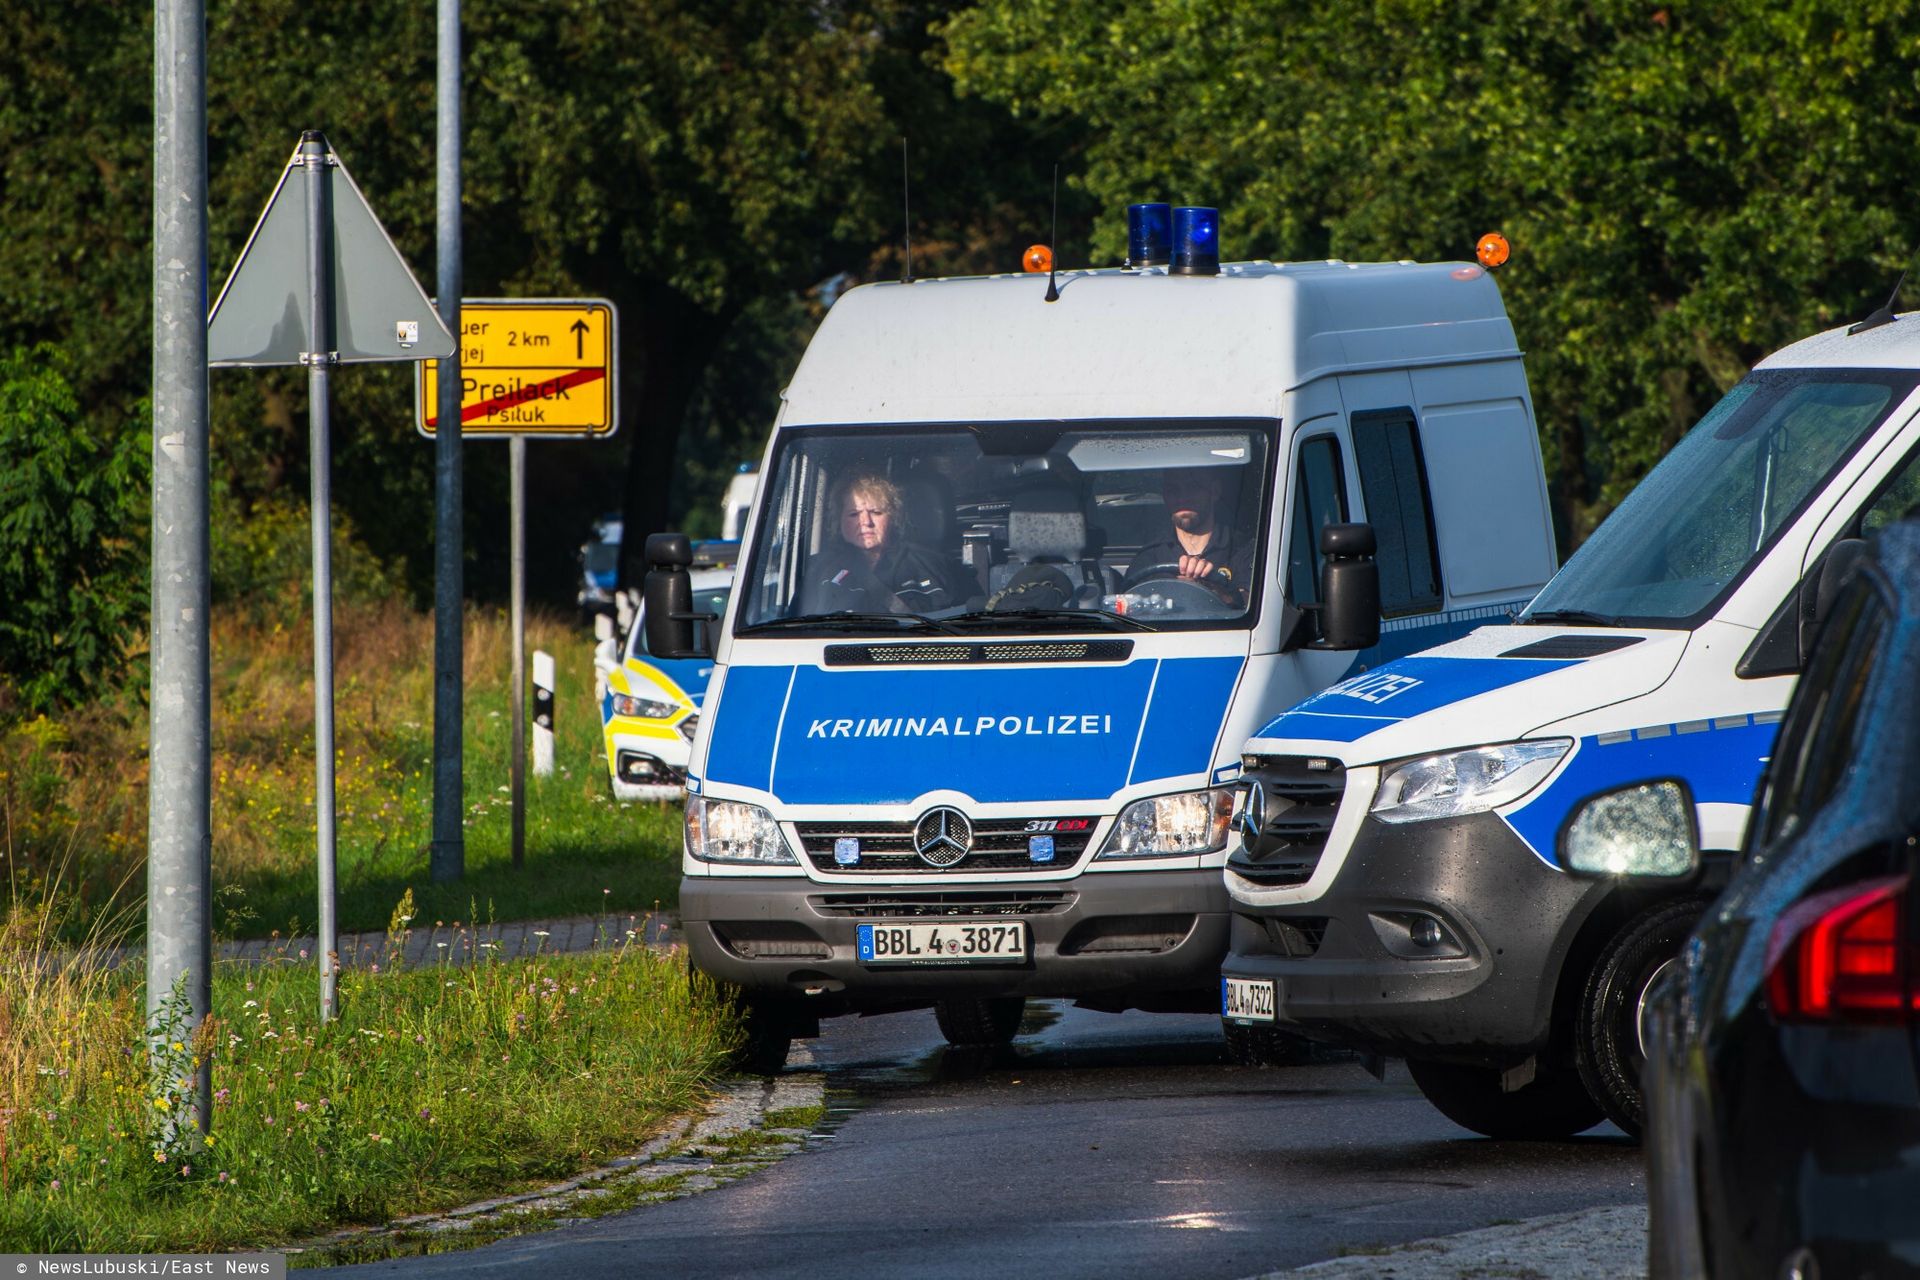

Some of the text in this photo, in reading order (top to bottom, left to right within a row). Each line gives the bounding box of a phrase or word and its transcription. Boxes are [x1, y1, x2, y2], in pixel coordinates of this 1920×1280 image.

[461, 323, 489, 335] uer
[508, 331, 550, 346] 2 km
[461, 344, 484, 363] jej
[461, 378, 570, 401] Preilack
[807, 715, 1111, 738] KRIMINALPOLIZEI
[875, 929, 921, 955] BBL
[929, 929, 943, 954] 4
[962, 926, 1023, 953] 3871
[1249, 984, 1273, 1015] 7322
